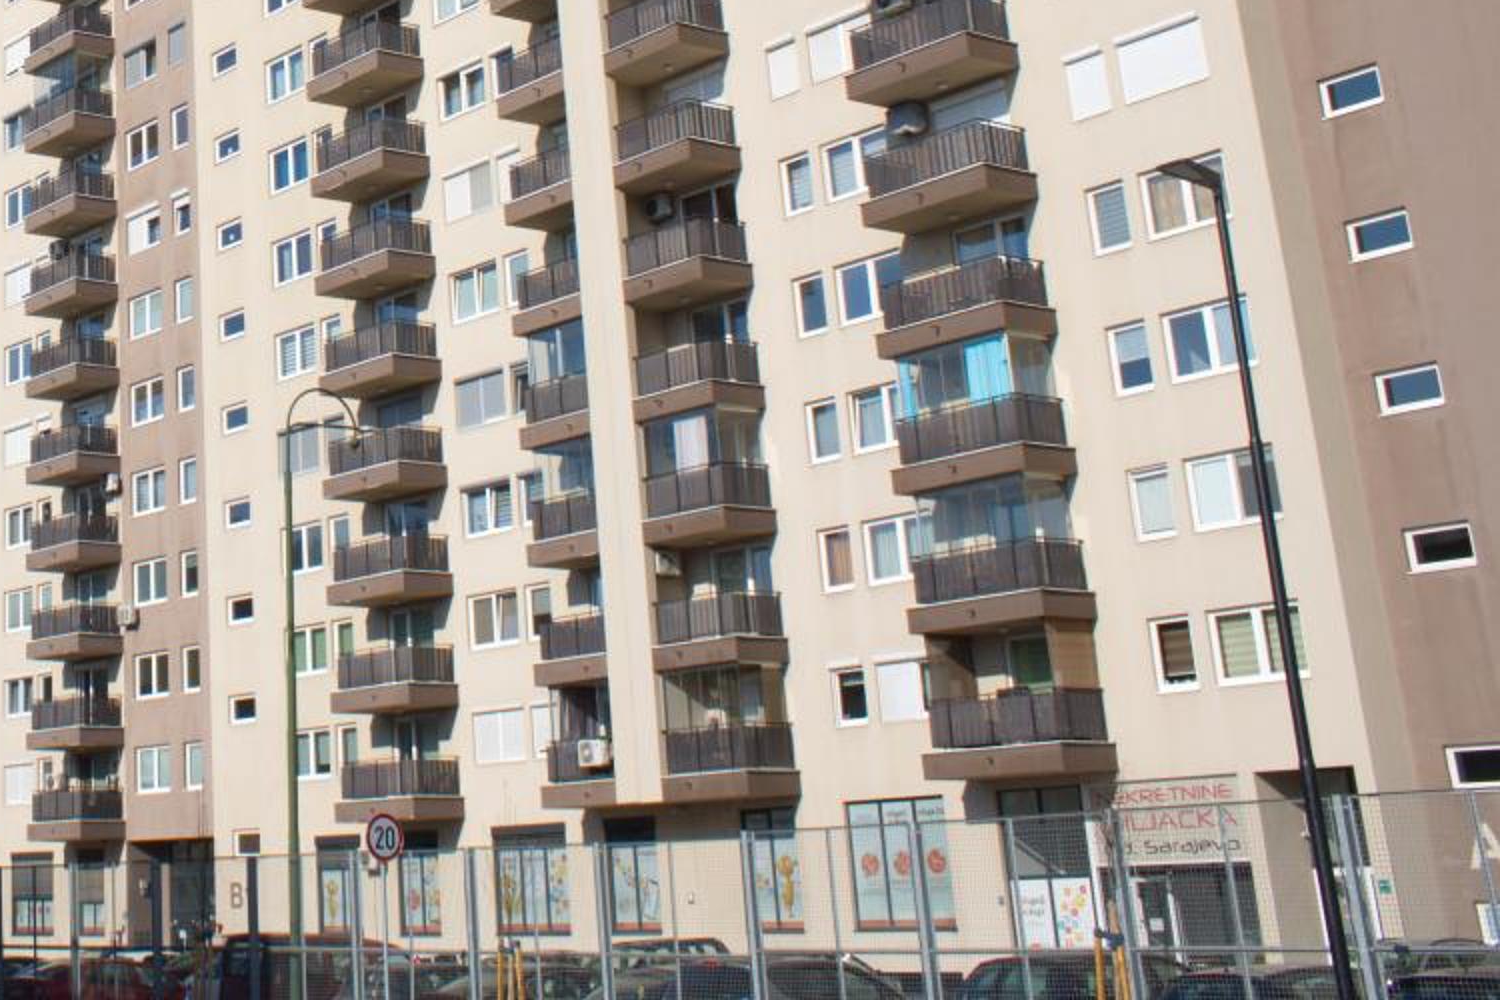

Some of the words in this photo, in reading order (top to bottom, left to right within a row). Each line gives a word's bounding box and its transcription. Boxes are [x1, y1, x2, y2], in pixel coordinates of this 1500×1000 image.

[373, 825, 396, 850] 20
[1096, 807, 1238, 840] ILJACKA
[229, 881, 244, 910] B
